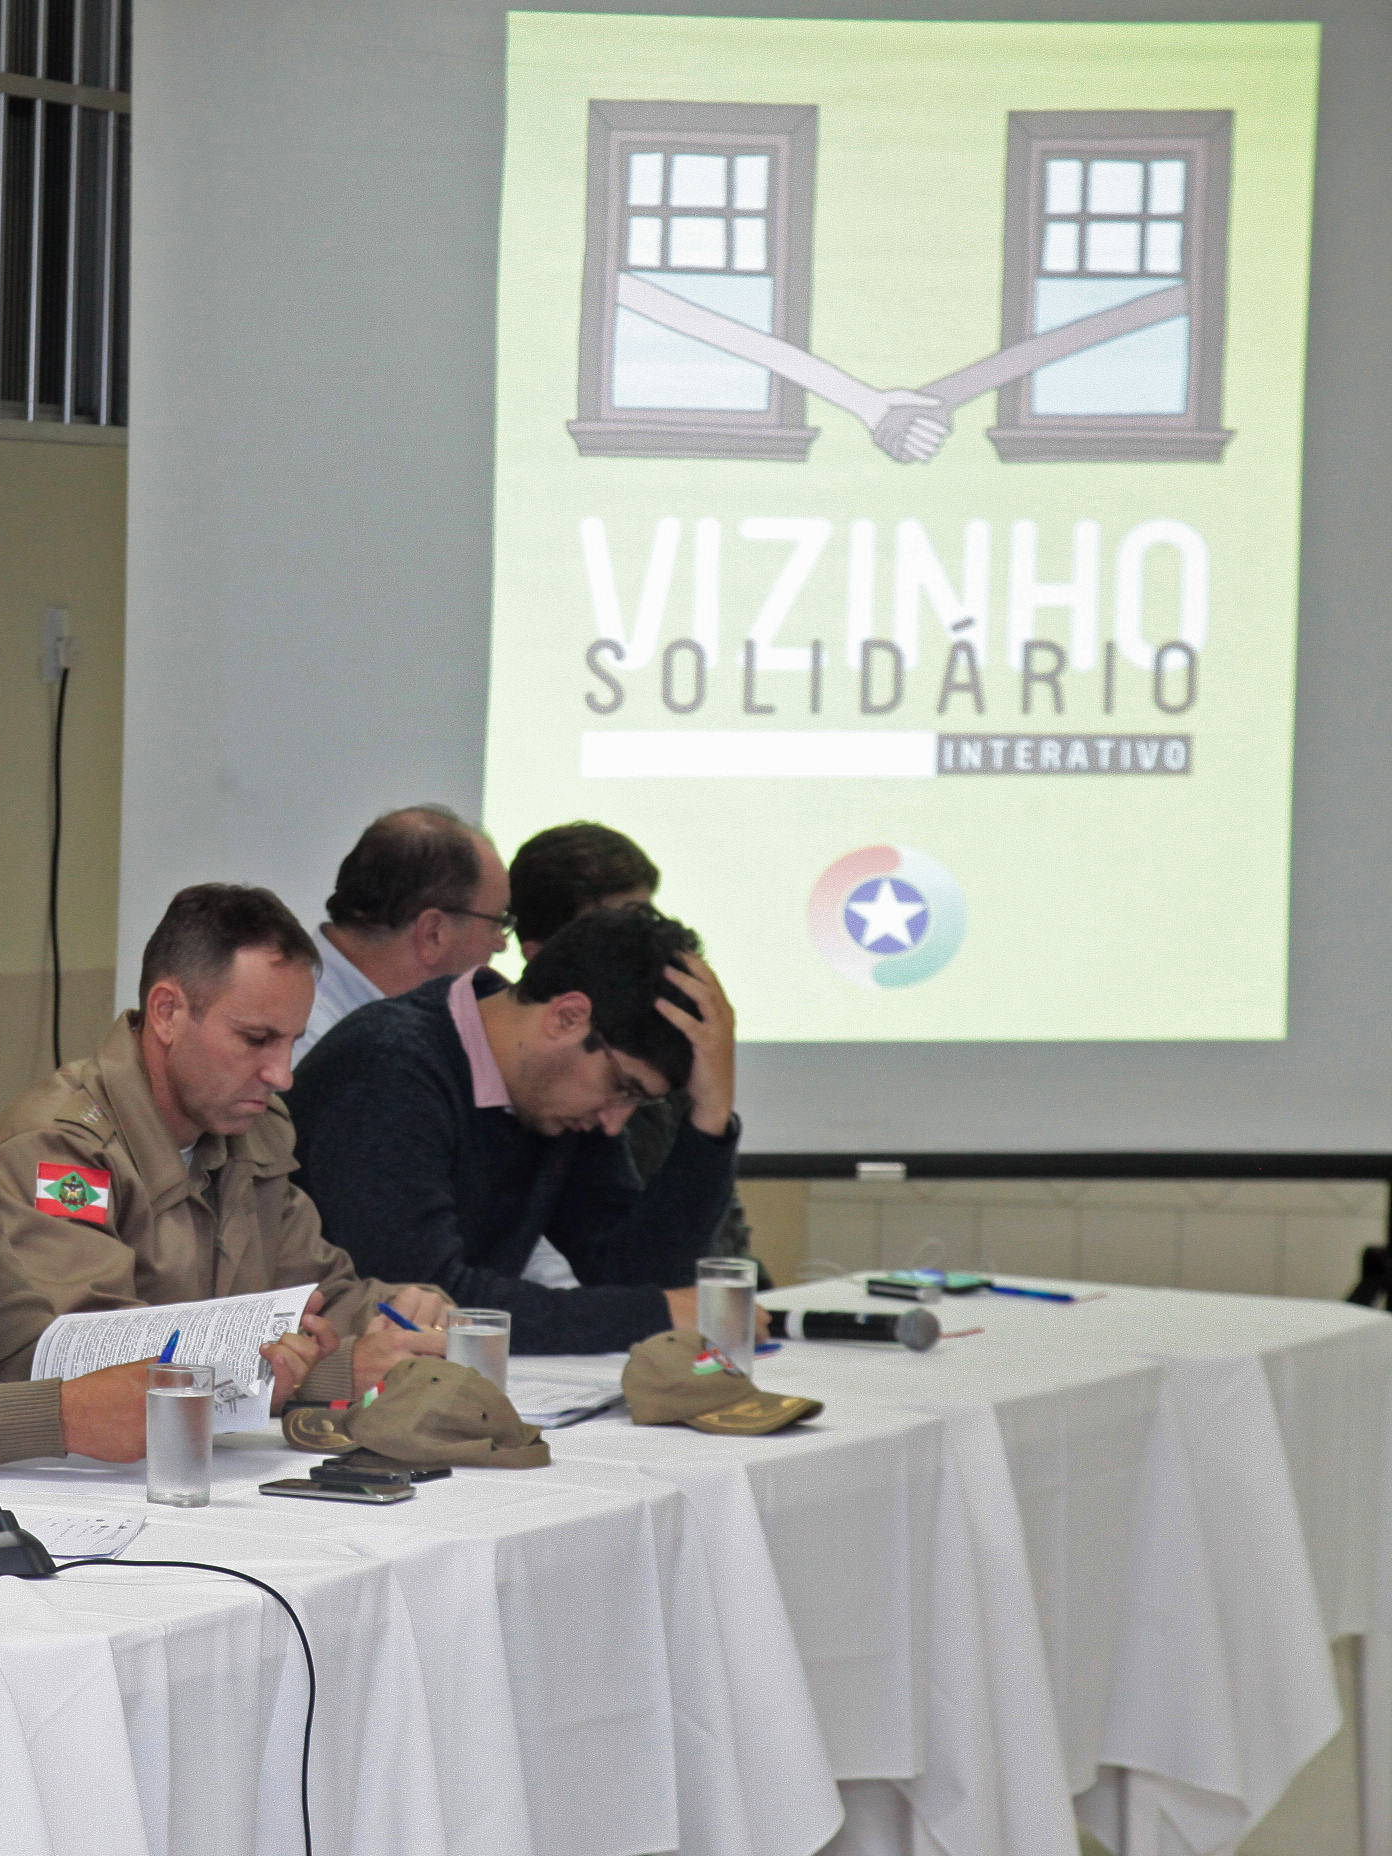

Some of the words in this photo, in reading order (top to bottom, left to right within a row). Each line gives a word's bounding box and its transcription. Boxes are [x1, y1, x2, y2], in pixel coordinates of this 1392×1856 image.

[579, 516, 1211, 671] VIZINHO
[584, 616, 1199, 714] SOLIDÁRIO
[942, 737, 1188, 771] INTERATIVO
